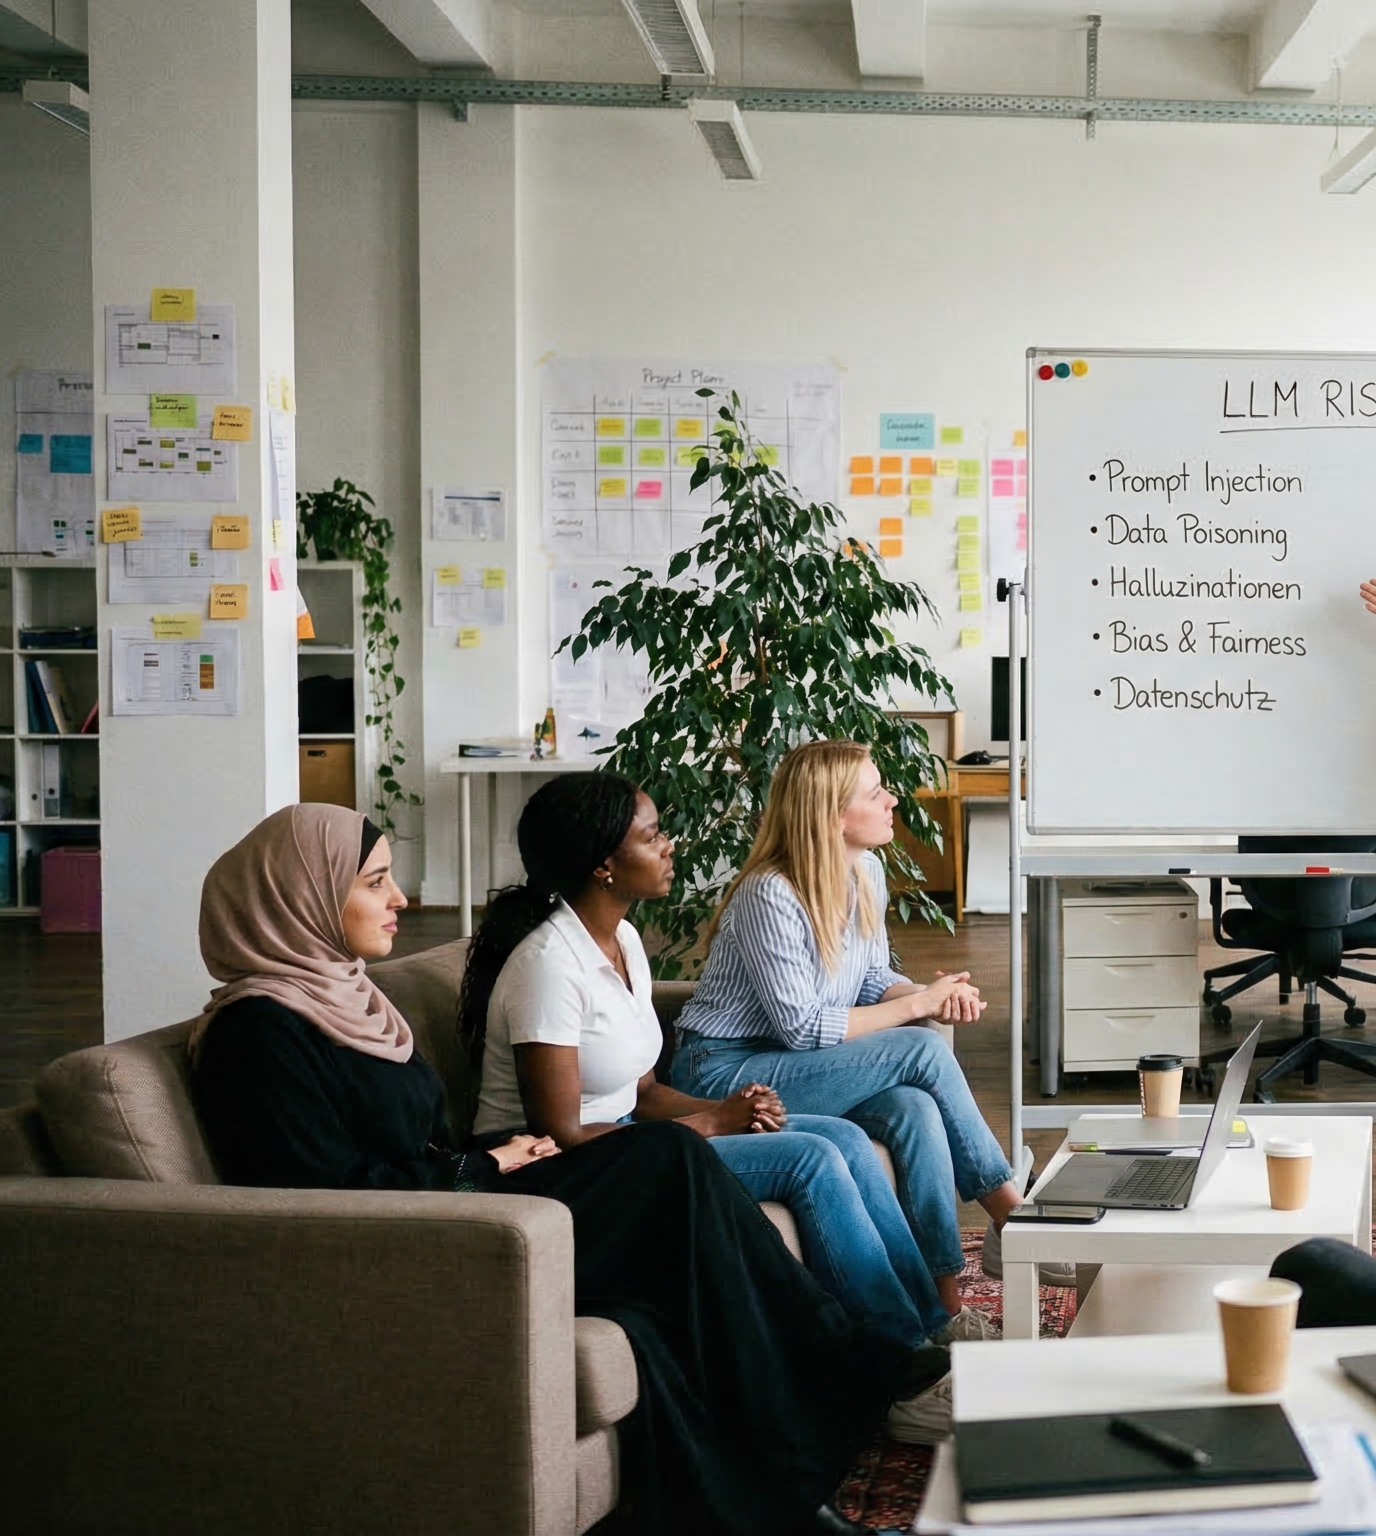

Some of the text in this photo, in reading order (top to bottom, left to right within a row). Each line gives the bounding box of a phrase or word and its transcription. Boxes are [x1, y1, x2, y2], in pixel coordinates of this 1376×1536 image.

[1223, 380, 1299, 418] LLM
[1103, 459, 1302, 505] Prompt Injection
[1105, 513, 1288, 562] Data Poisoning
[1110, 566, 1302, 600] Halluzinationen
[1108, 620, 1307, 657] Bias & Fairness
[1110, 676, 1277, 712] Datenschutz
